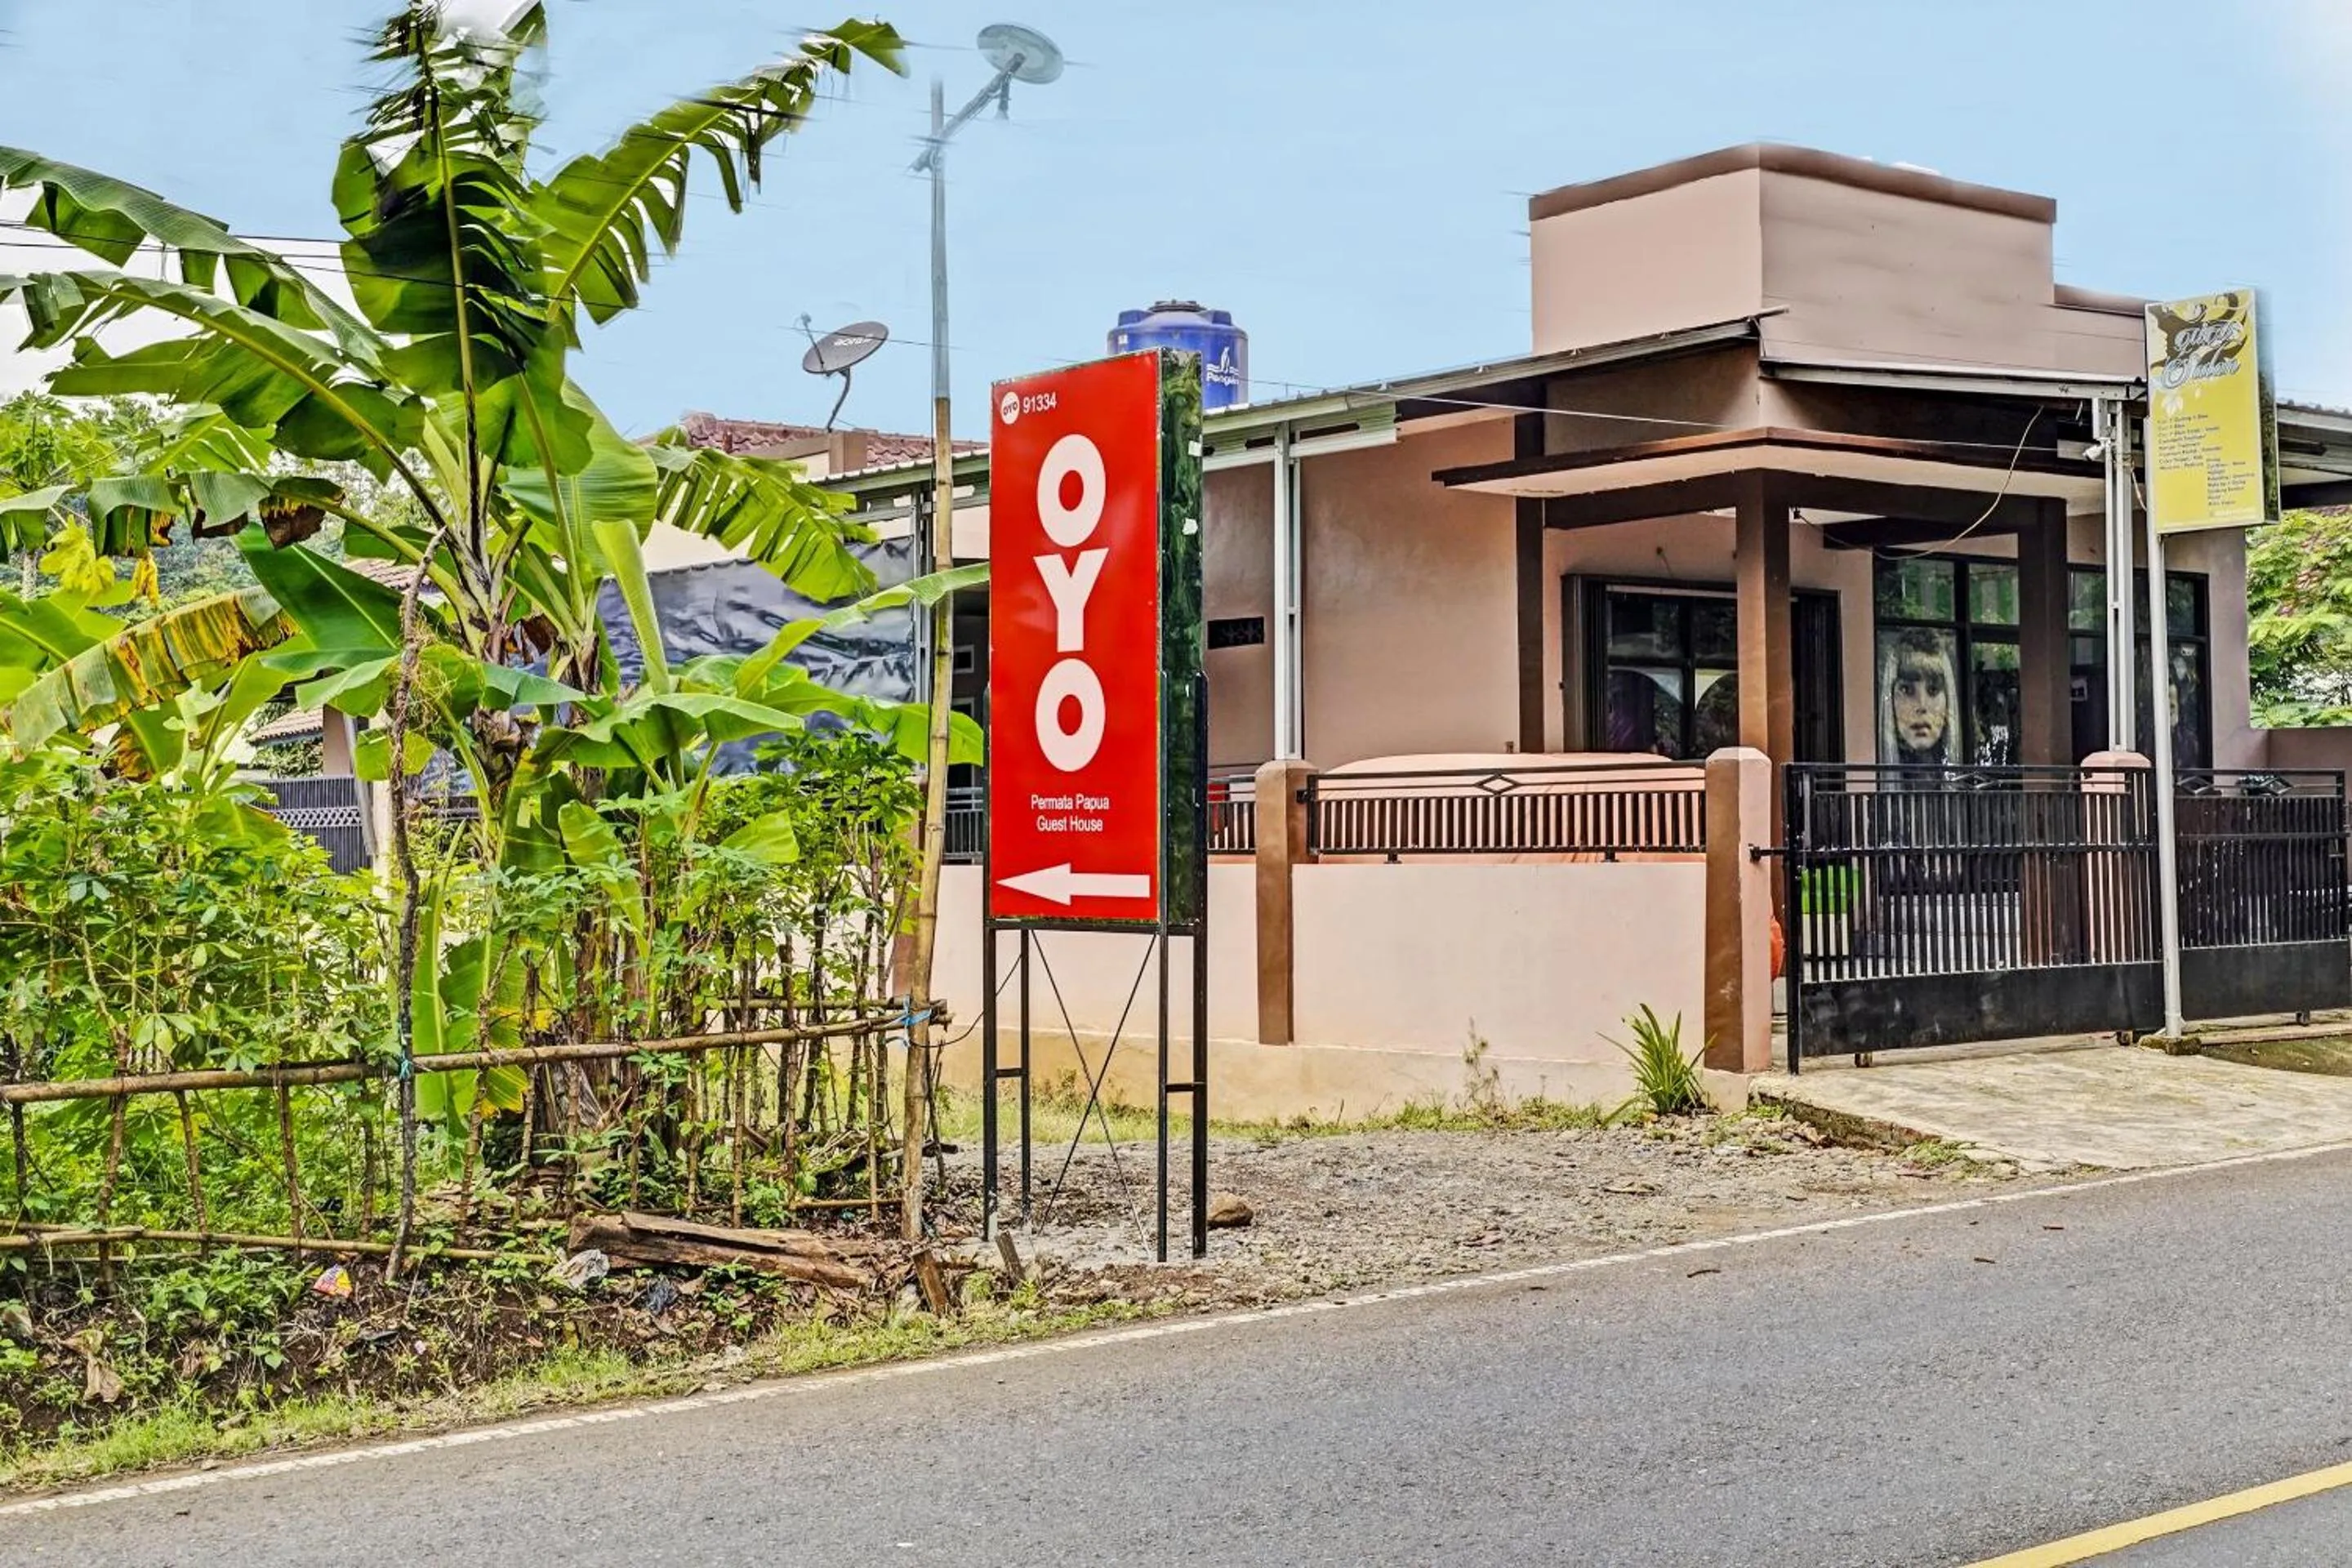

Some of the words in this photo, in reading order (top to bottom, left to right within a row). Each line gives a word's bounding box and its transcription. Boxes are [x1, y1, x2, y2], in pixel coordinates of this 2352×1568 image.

[1022, 392, 1058, 414] 91334
[1034, 434, 1109, 771] OYO
[1031, 795, 1073, 810] Permata
[1076, 794, 1110, 811] Papua
[1036, 815, 1067, 831] Guest
[1070, 815, 1103, 831] House
